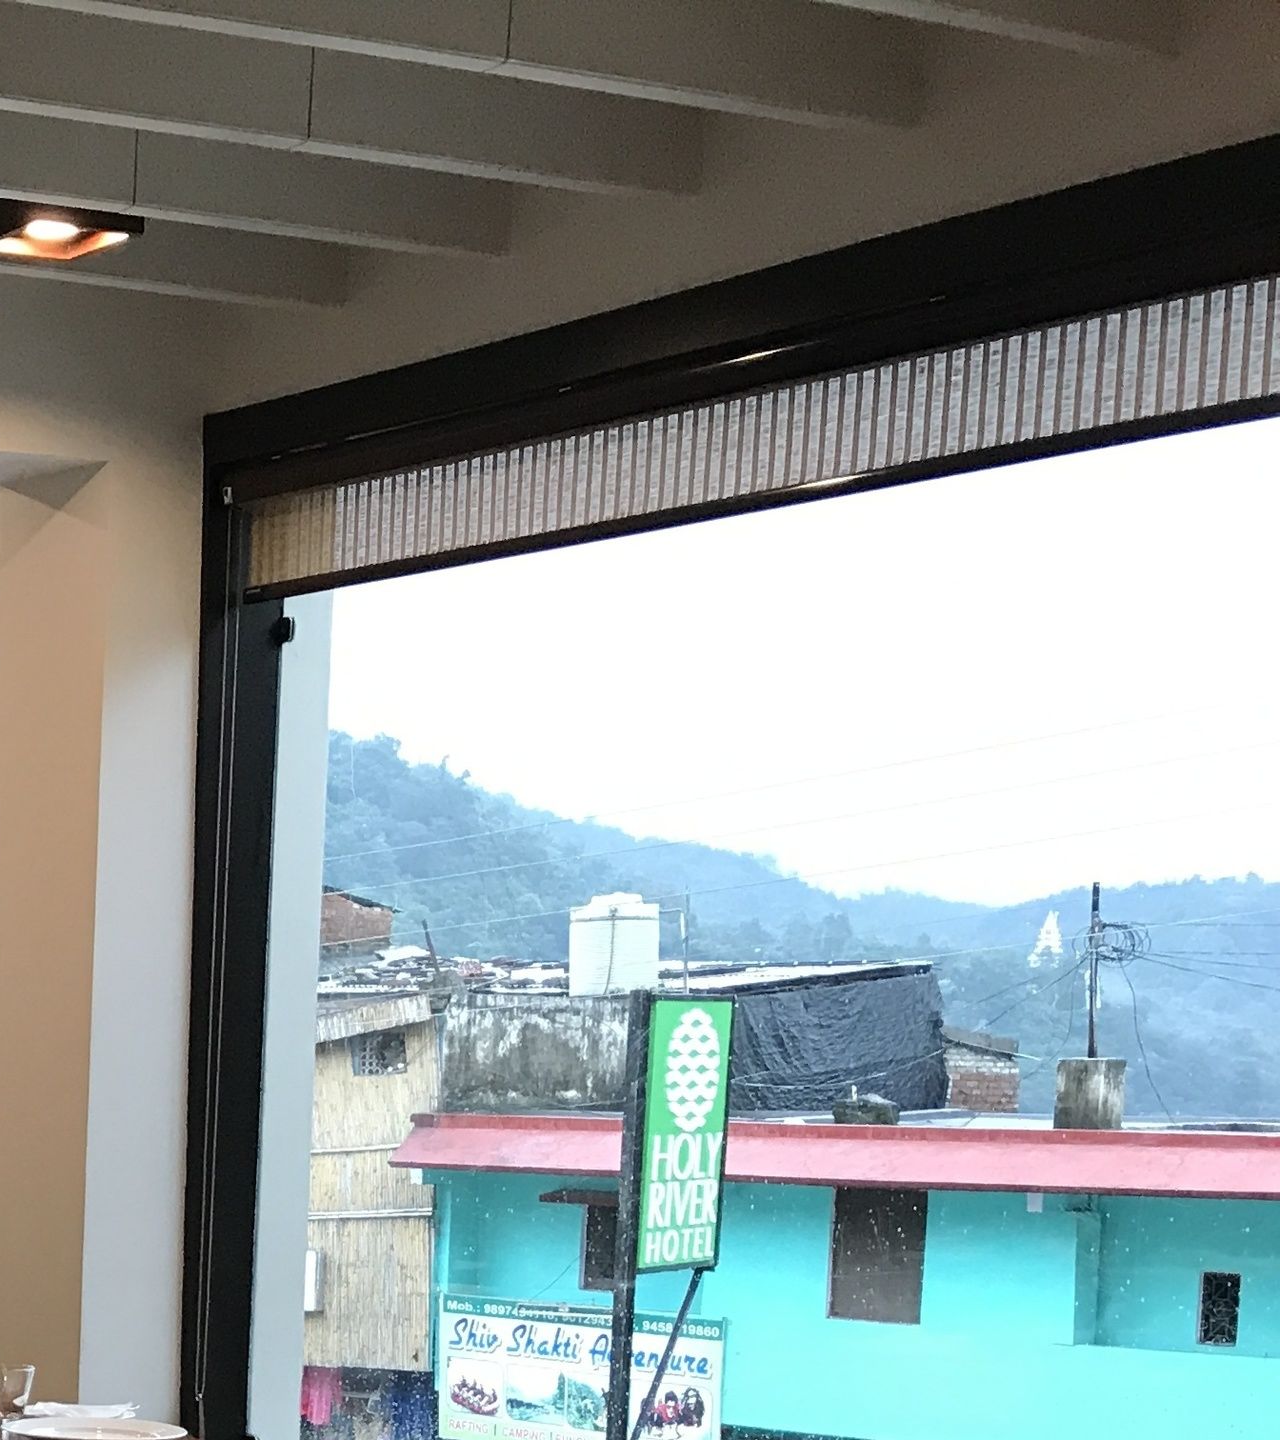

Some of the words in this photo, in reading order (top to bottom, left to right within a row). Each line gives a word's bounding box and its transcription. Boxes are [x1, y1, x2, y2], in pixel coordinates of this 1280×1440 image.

[651, 1132, 724, 1181] HOLY
[647, 1179, 719, 1229] RIVER
[644, 1226, 714, 1264] HOTEL
[448, 1317, 499, 1350] Shiv
[506, 1324, 581, 1360] Shakti
[589, 1333, 709, 1375] Aenure
[642, 1320, 721, 1338] 945819860
[448, 1418, 489, 1434] RAFTING
